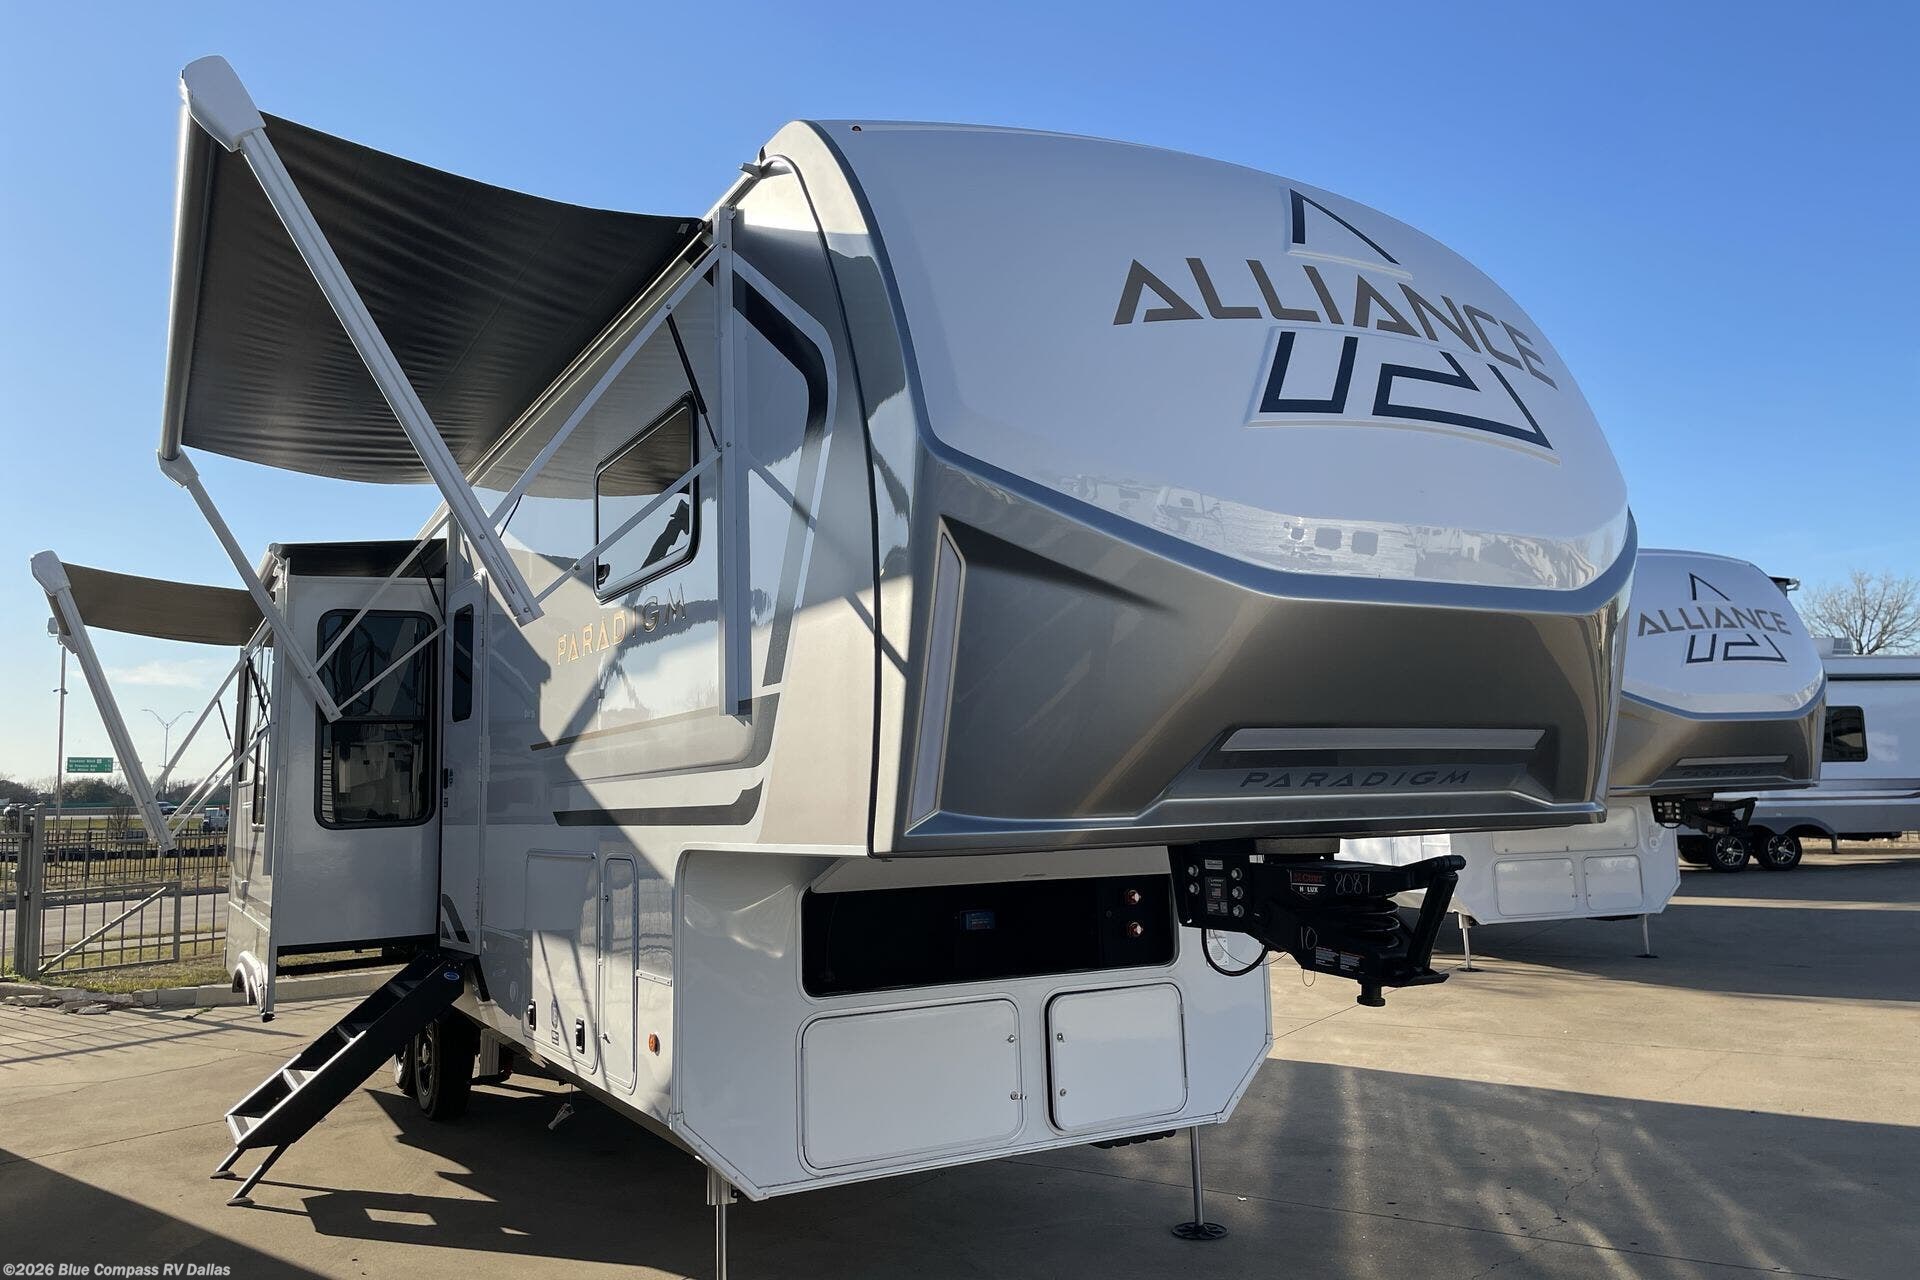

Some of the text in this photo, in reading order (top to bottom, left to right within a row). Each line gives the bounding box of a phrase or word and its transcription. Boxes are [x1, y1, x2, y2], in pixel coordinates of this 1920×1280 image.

[1112, 257, 1558, 391] ALLIANCE
[556, 582, 687, 665] PARADIGM
[1637, 605, 1793, 637] ALLIANCE
[1239, 769, 1471, 788] PARADIGM
[1299, 885, 1319, 893] HLUX
